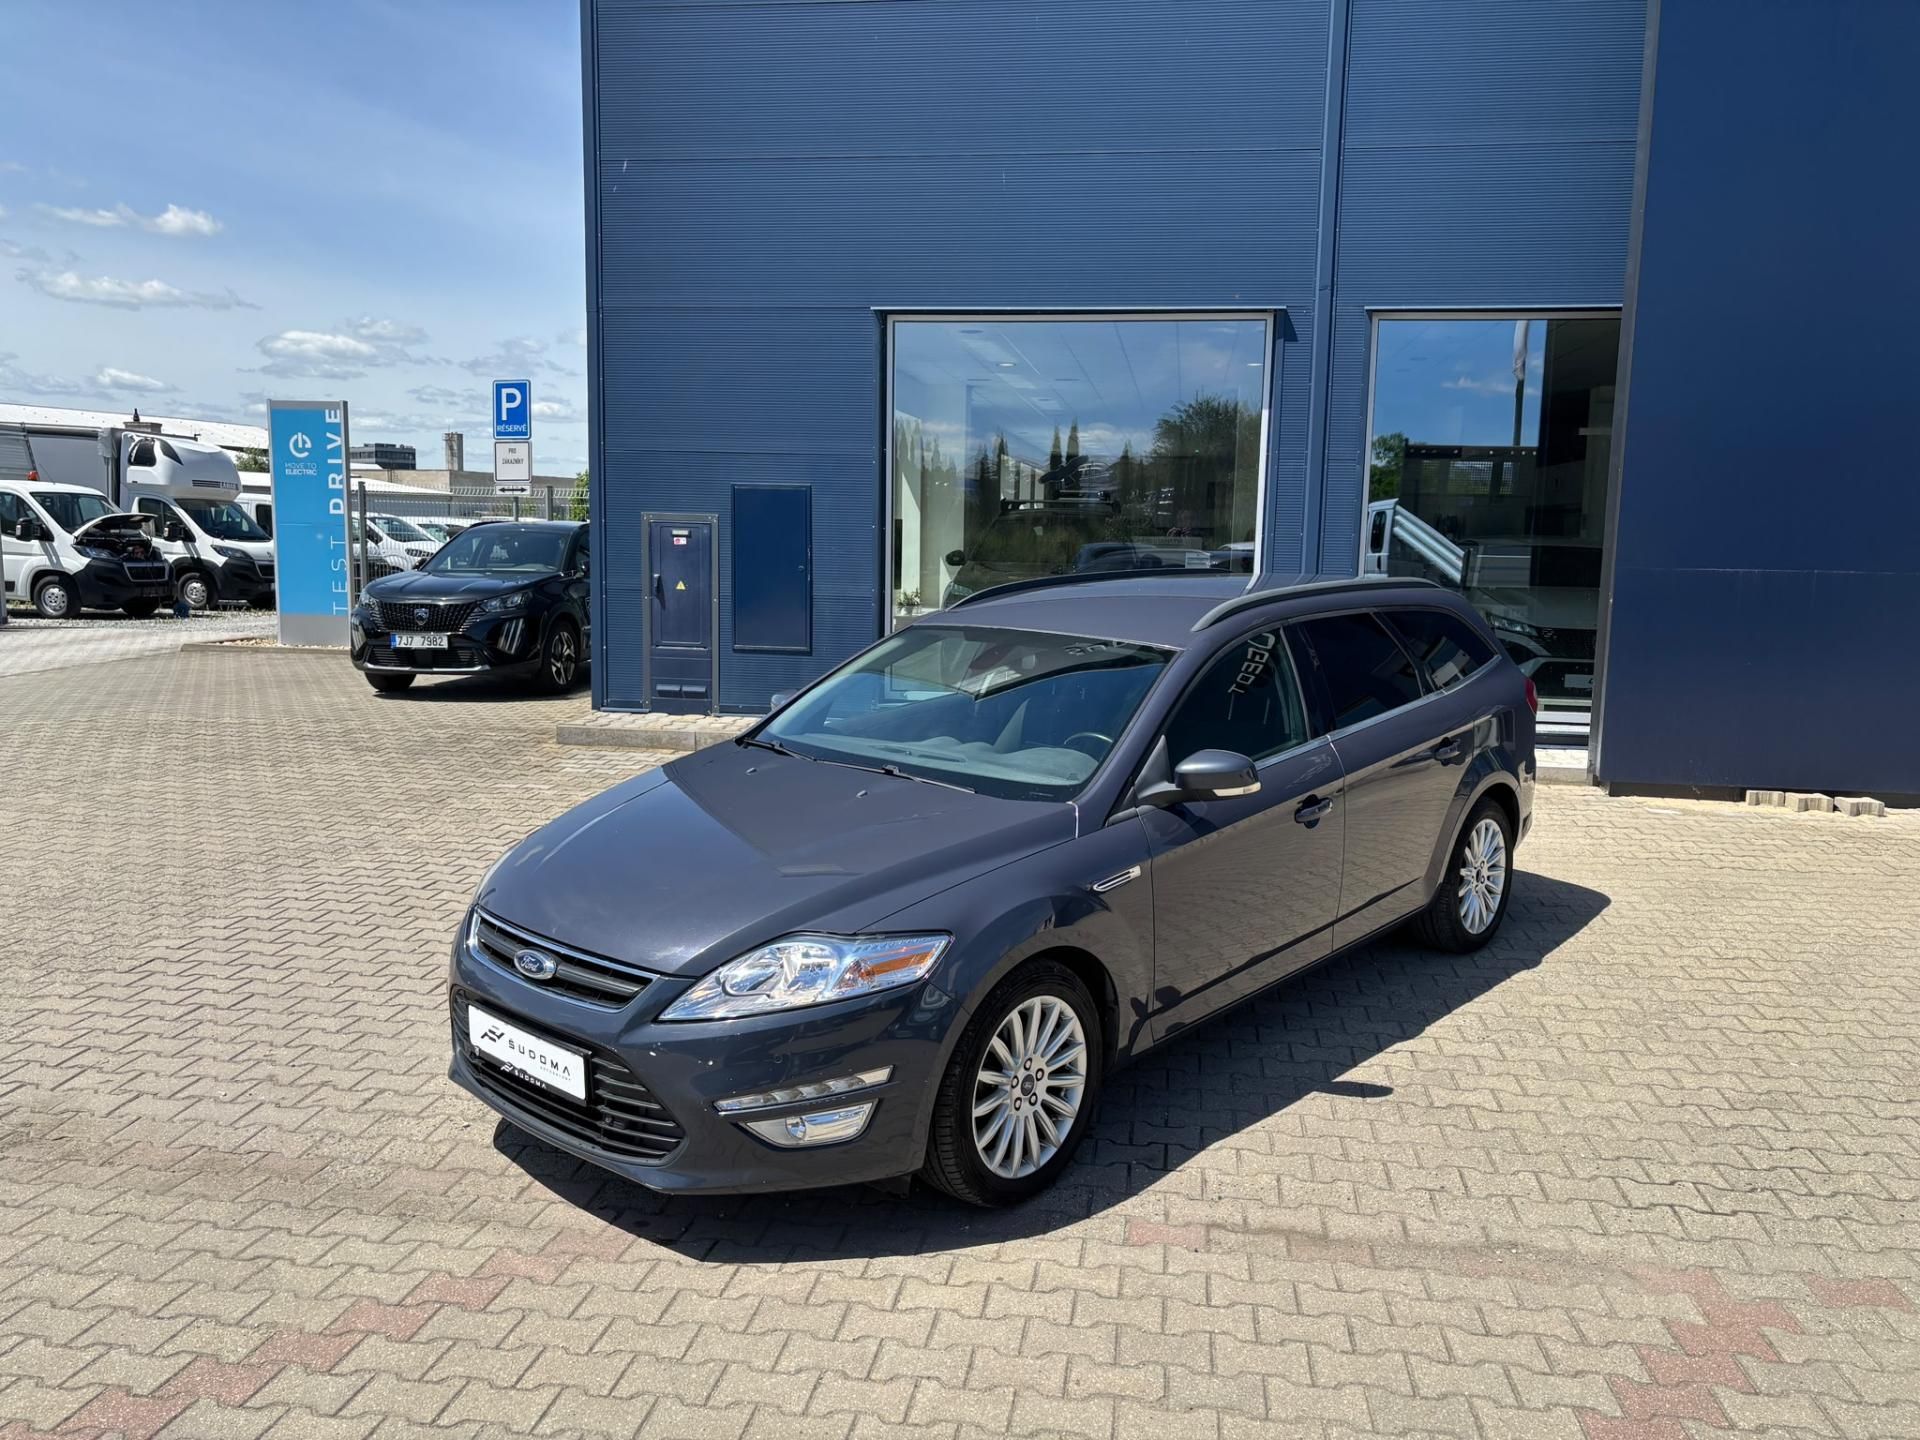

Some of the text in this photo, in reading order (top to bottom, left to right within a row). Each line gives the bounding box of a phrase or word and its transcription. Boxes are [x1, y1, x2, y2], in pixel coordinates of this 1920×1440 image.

[501, 388, 521, 420] P
[325, 409, 348, 615] TEST DRIVE
[398, 636, 444, 646] 7J7 7982
[520, 955, 540, 972] Ford
